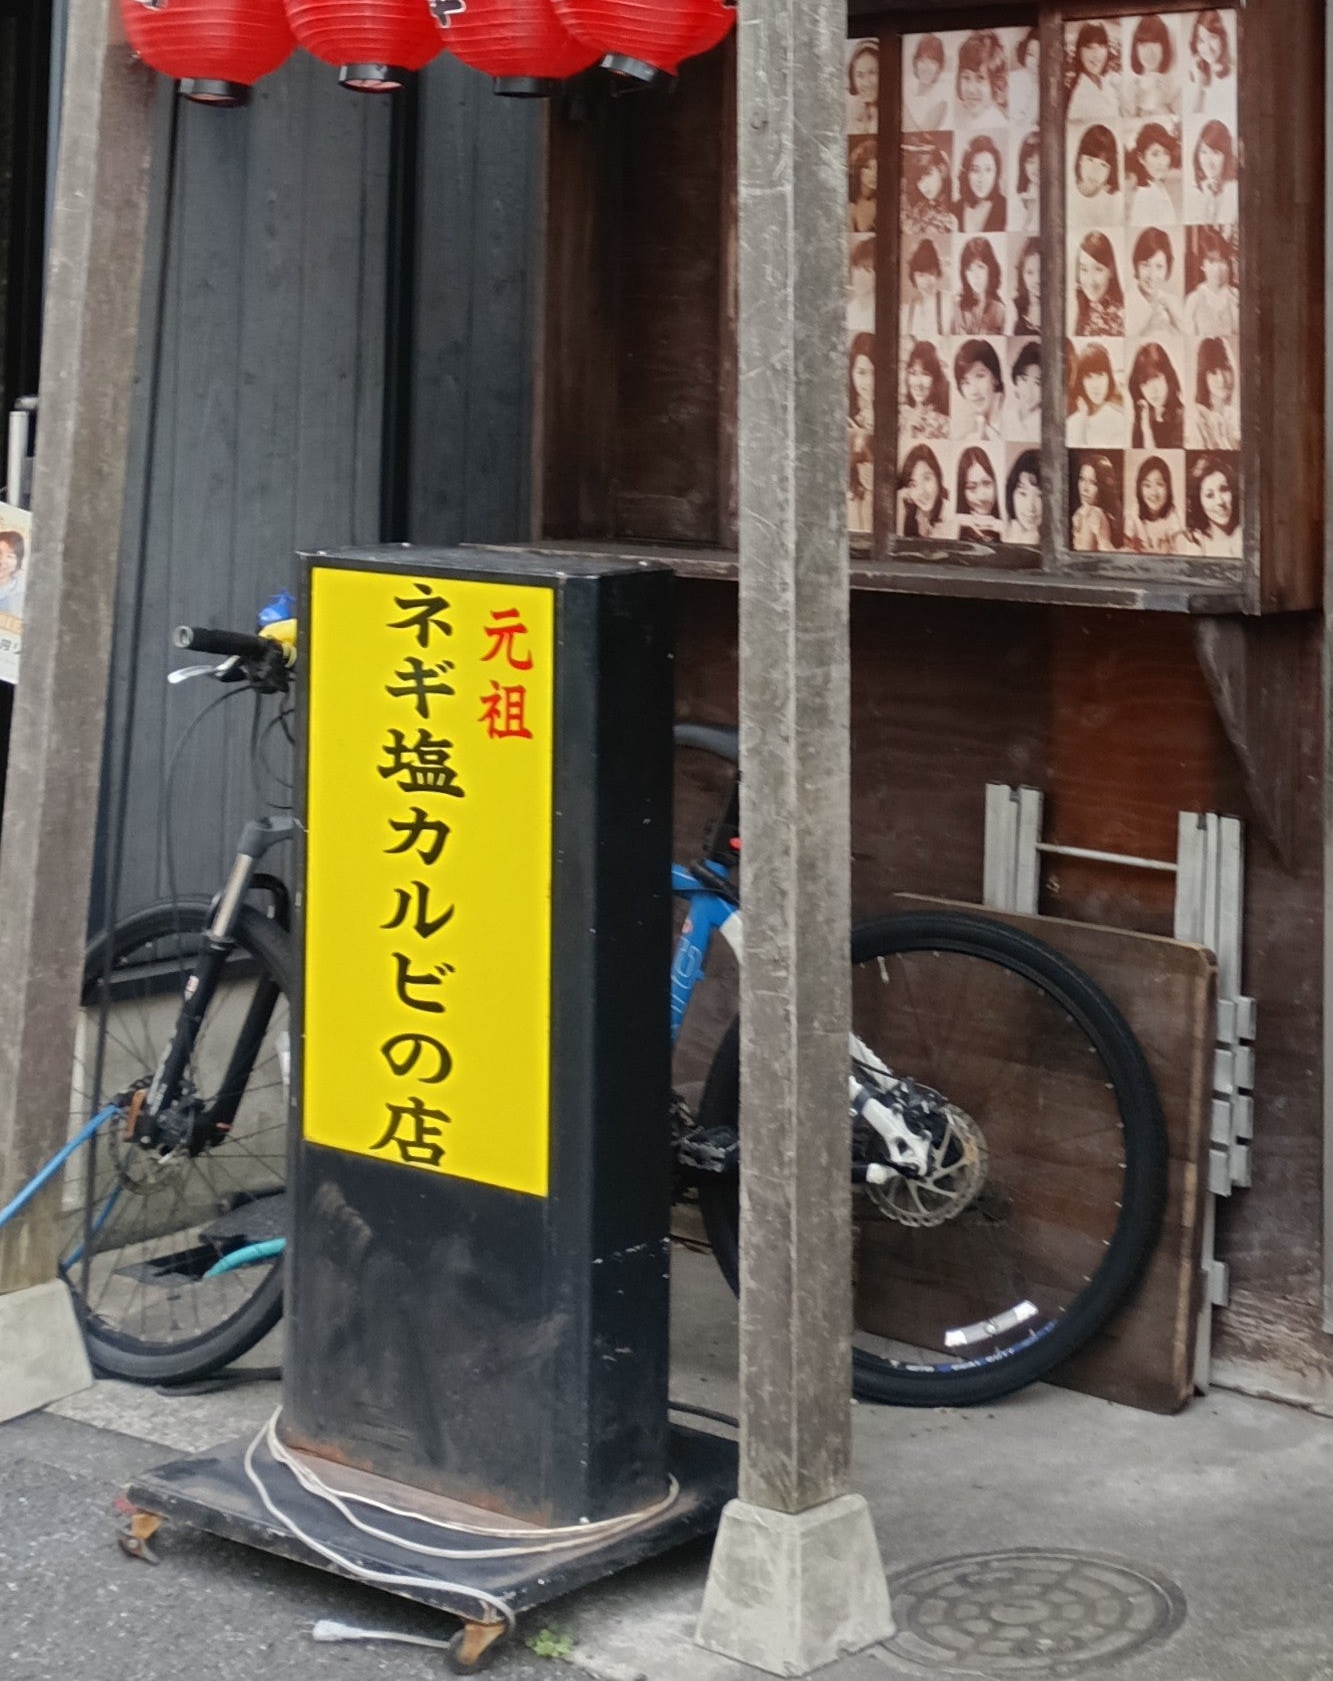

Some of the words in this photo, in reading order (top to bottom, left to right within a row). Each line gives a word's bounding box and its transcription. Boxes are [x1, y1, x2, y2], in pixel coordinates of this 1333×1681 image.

[477, 607, 534, 740] 元祖
[370, 582, 466, 1169] ネギ塩カルビの店
